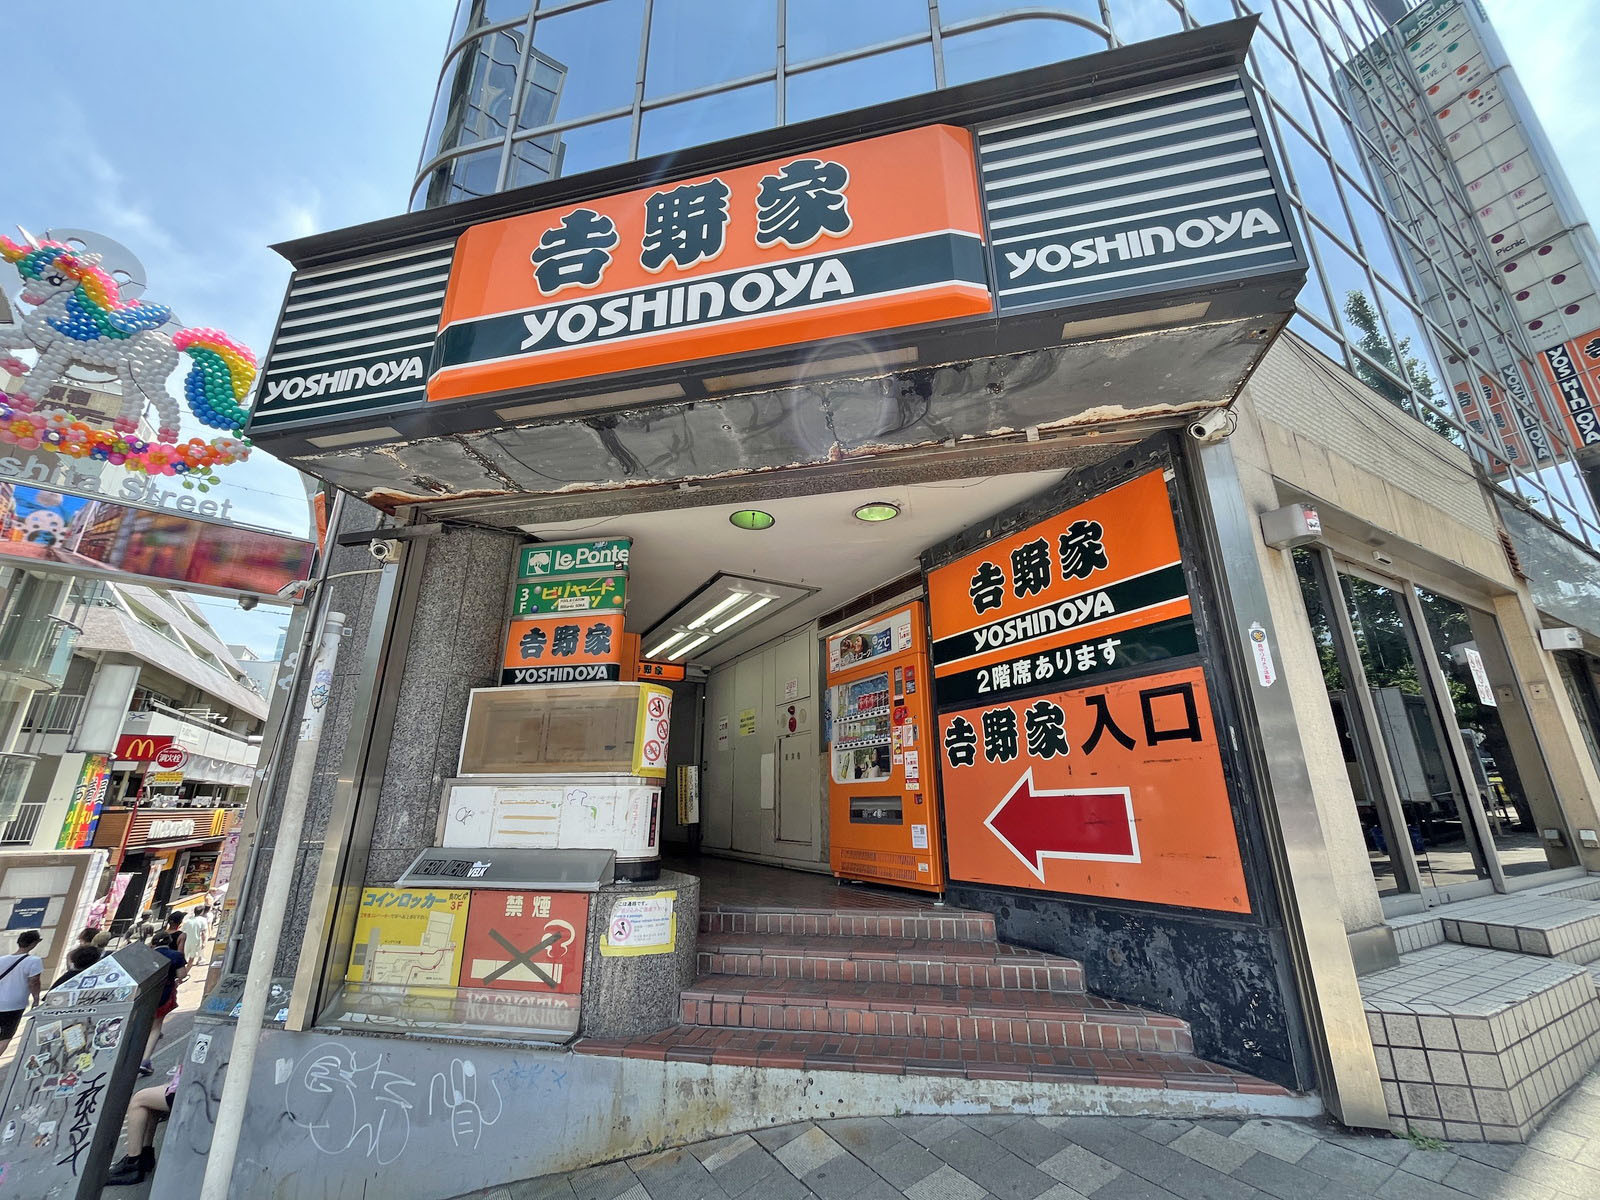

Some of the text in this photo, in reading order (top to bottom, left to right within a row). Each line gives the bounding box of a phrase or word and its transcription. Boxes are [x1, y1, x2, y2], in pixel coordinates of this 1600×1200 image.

[531, 159, 853, 296] 吉野家
[1004, 207, 1281, 280] YOSHINOYA
[1496, 238, 1526, 256] Picnic
[520, 258, 855, 351] YOSHINOYA
[263, 356, 424, 404] YOSHINOYA
[1548, 346, 1600, 444] YOSHINOYA
[118, 475, 233, 521] Street
[576, 545, 629, 565] Ponte
[969, 520, 1109, 615] 吉野家
[542, 582, 615, 599] ビリヤード
[520, 622, 612, 659] 吉野家
[973, 591, 1115, 652] YOSHINOYA
[514, 666, 608, 683] YOSHINOYA
[638, 665, 664, 675] 野家
[977, 637, 1122, 693] 2階席あります
[945, 682, 1203, 768] 吉野家 入口
[363, 891, 448, 909] コインロッカー
[450, 901, 463, 911] 3F
[505, 895, 552, 918] 禁煙
